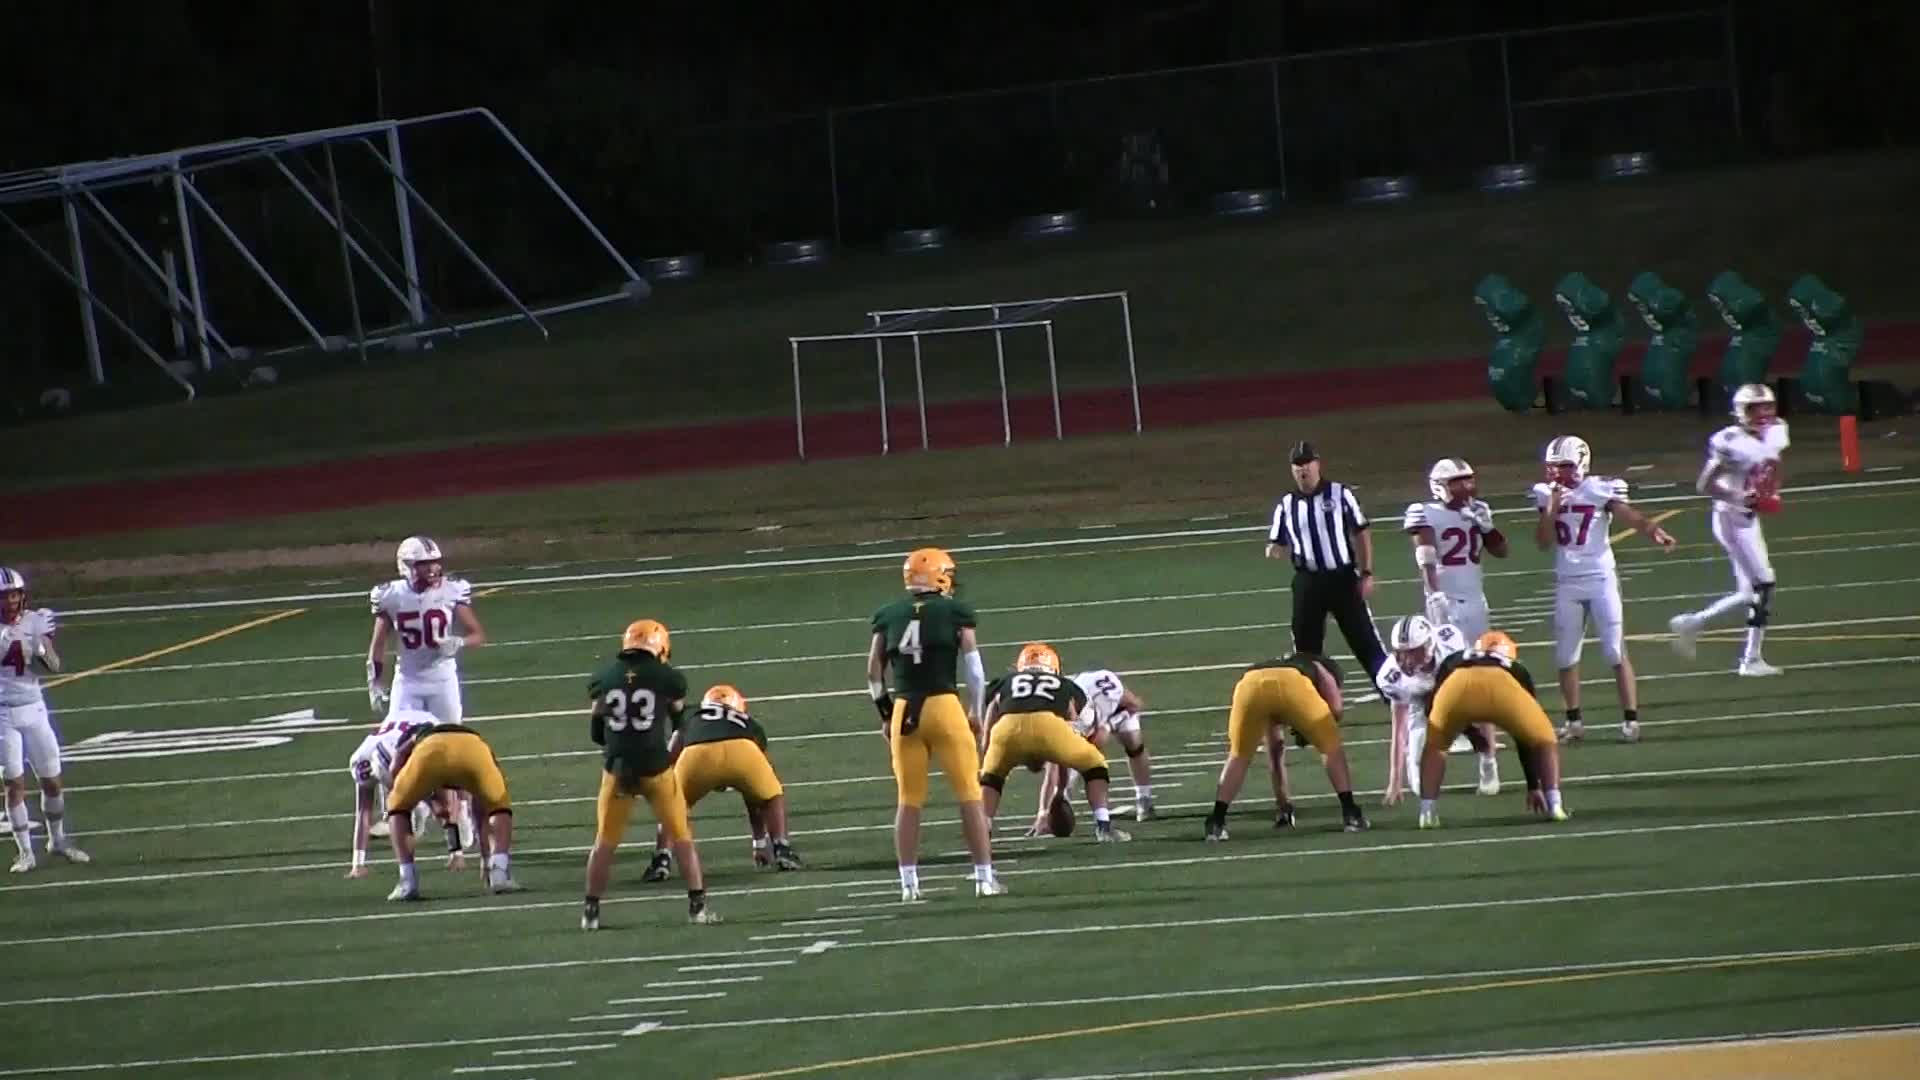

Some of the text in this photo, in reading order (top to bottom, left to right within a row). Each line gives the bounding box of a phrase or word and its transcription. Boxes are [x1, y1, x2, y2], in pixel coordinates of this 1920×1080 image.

[397, 608, 447, 650] 50
[898, 619, 922, 665] 4
[1011, 674, 1062, 701] 62
[605, 688, 656, 731] 33
